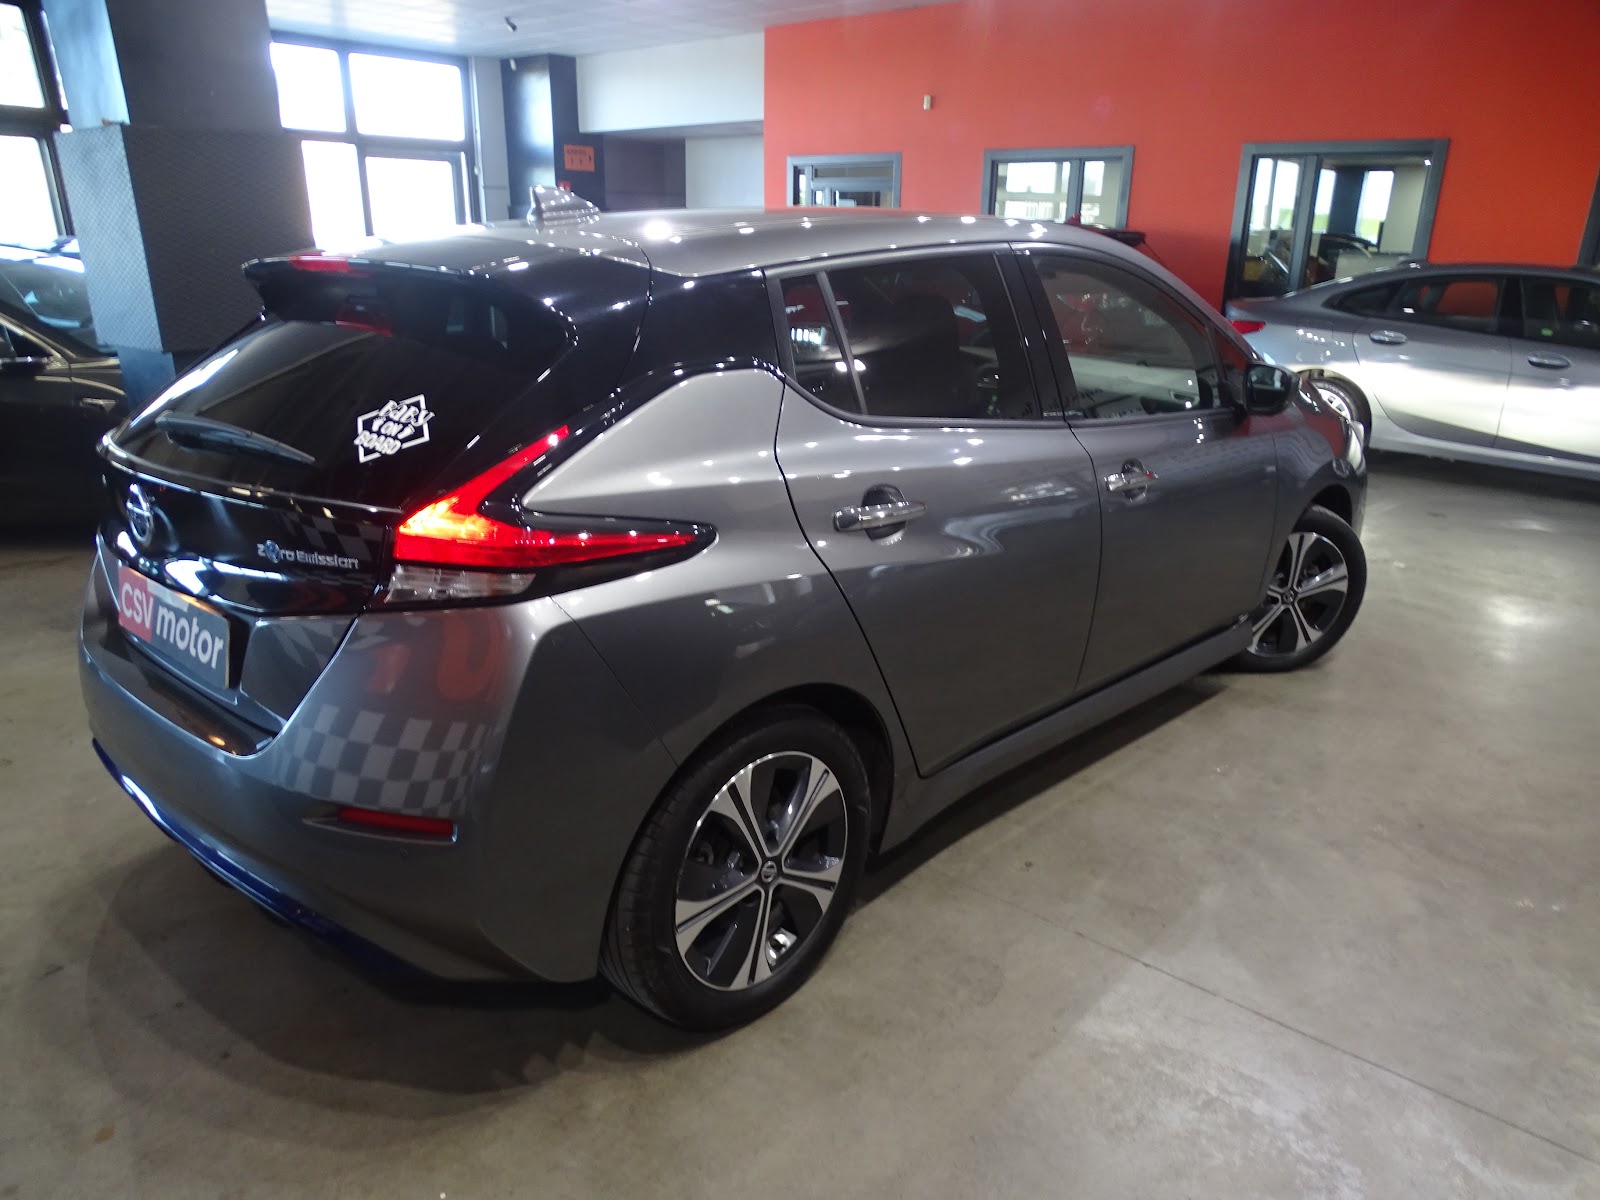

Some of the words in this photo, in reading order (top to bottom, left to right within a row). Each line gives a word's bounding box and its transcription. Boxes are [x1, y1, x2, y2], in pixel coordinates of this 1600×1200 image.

[381, 421, 403, 437] ON
[354, 430, 402, 455] BOARD
[296, 550, 359, 570] Emission
[121, 582, 154, 630] CSV
[156, 604, 224, 669] motor
